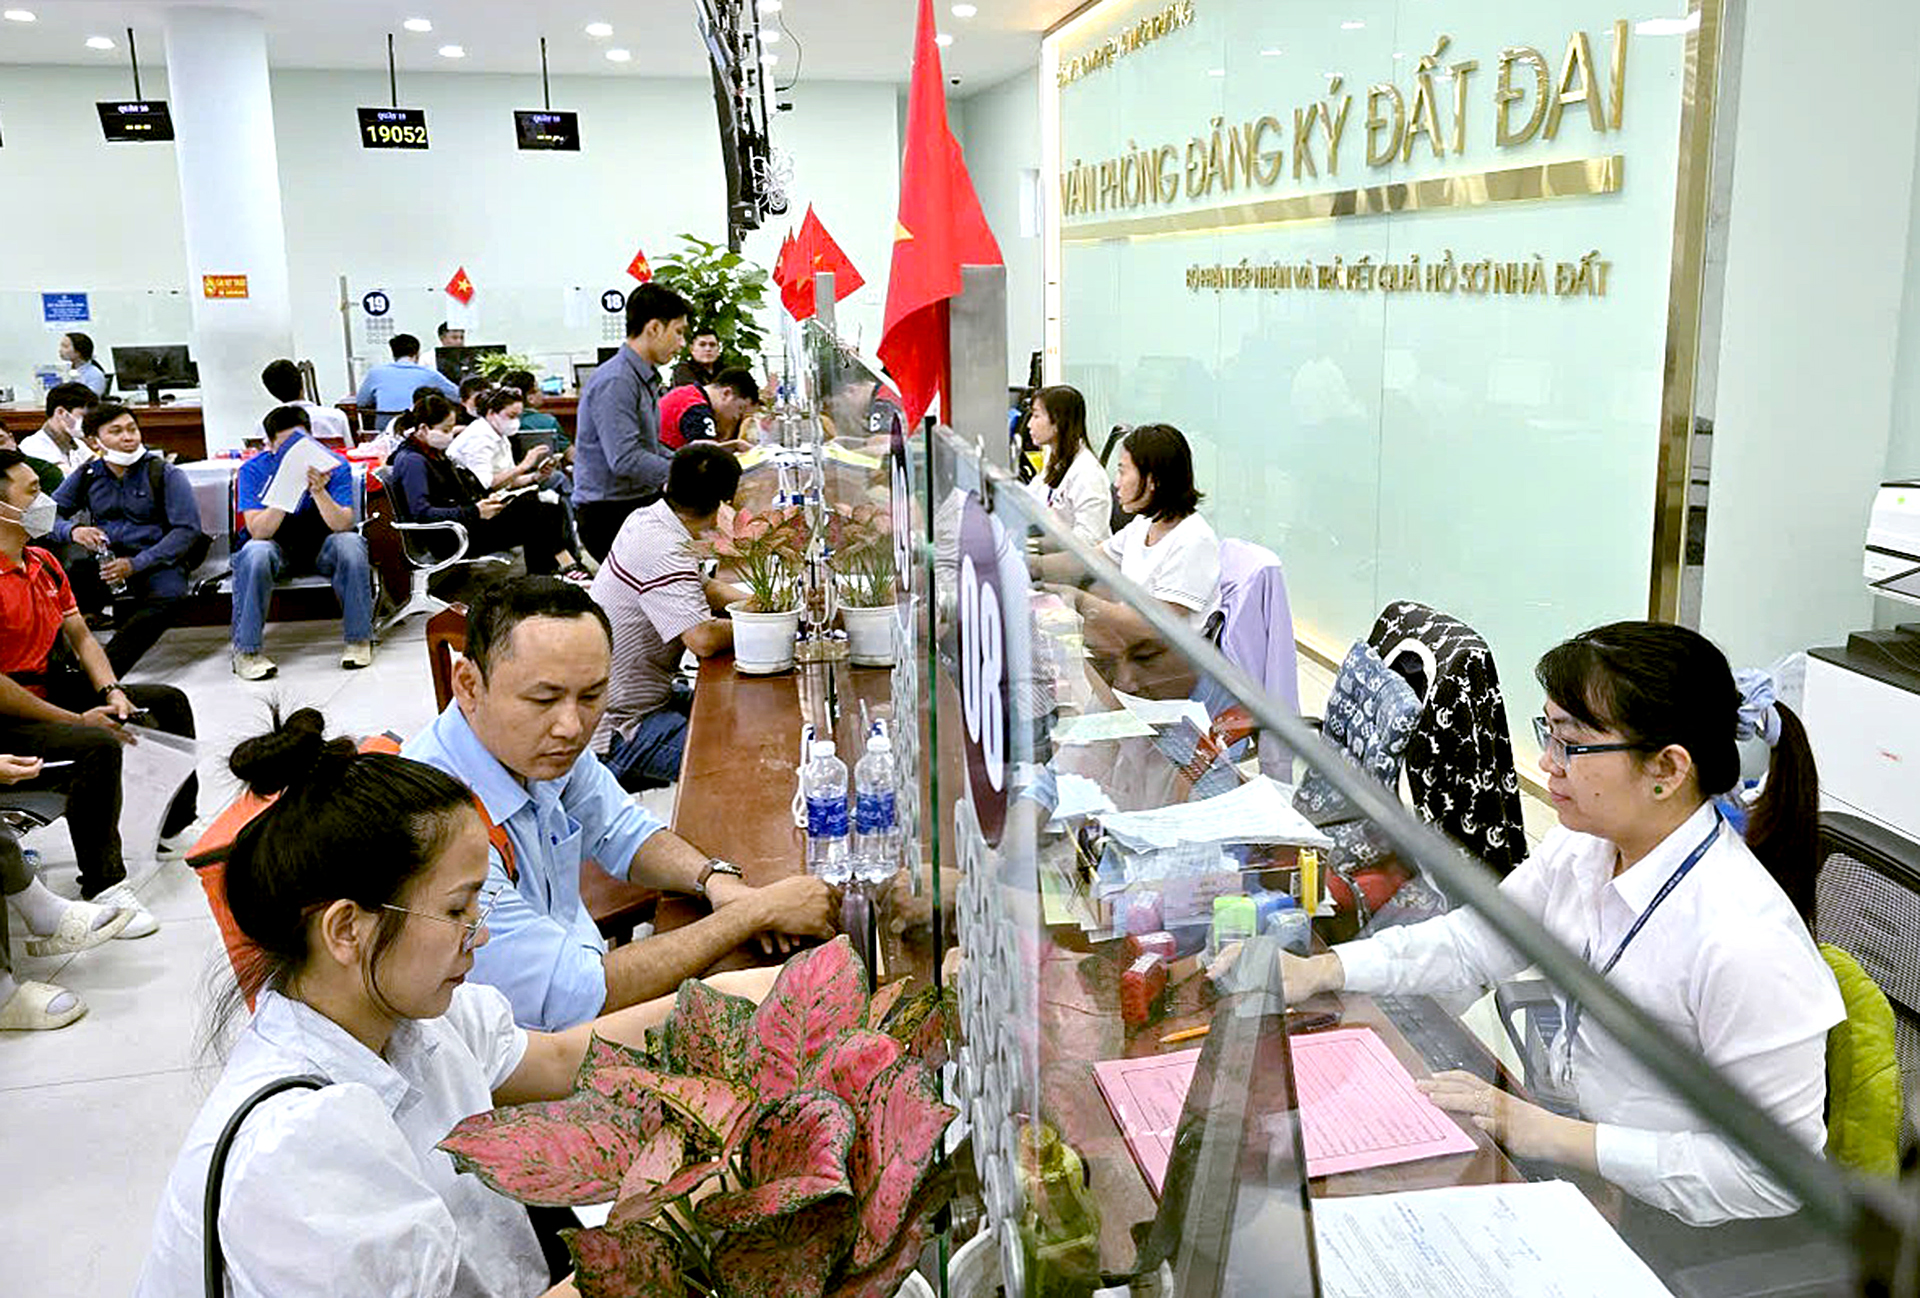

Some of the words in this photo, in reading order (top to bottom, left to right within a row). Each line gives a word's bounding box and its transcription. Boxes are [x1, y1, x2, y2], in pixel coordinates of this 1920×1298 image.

[1100, 138, 1180, 212] PHÒNG
[1185, 116, 1283, 201] ĐĂNG
[1292, 76, 1352, 181] KÝ
[1365, 35, 1479, 167] ĐẤT
[1495, 19, 1628, 147] ĐAI
[366, 124, 427, 143] 19052
[1378, 254, 1422, 293] QUẢ
[1426, 249, 1458, 293] HỒ
[1459, 258, 1490, 293] SƠ
[1493, 252, 1549, 295] NHÀ
[1554, 249, 1614, 297] ĐẤT
[366, 296, 386, 312] 19
[604, 294, 623, 309] 18
[703, 417, 717, 437] 3
[961, 553, 1004, 793] 08
